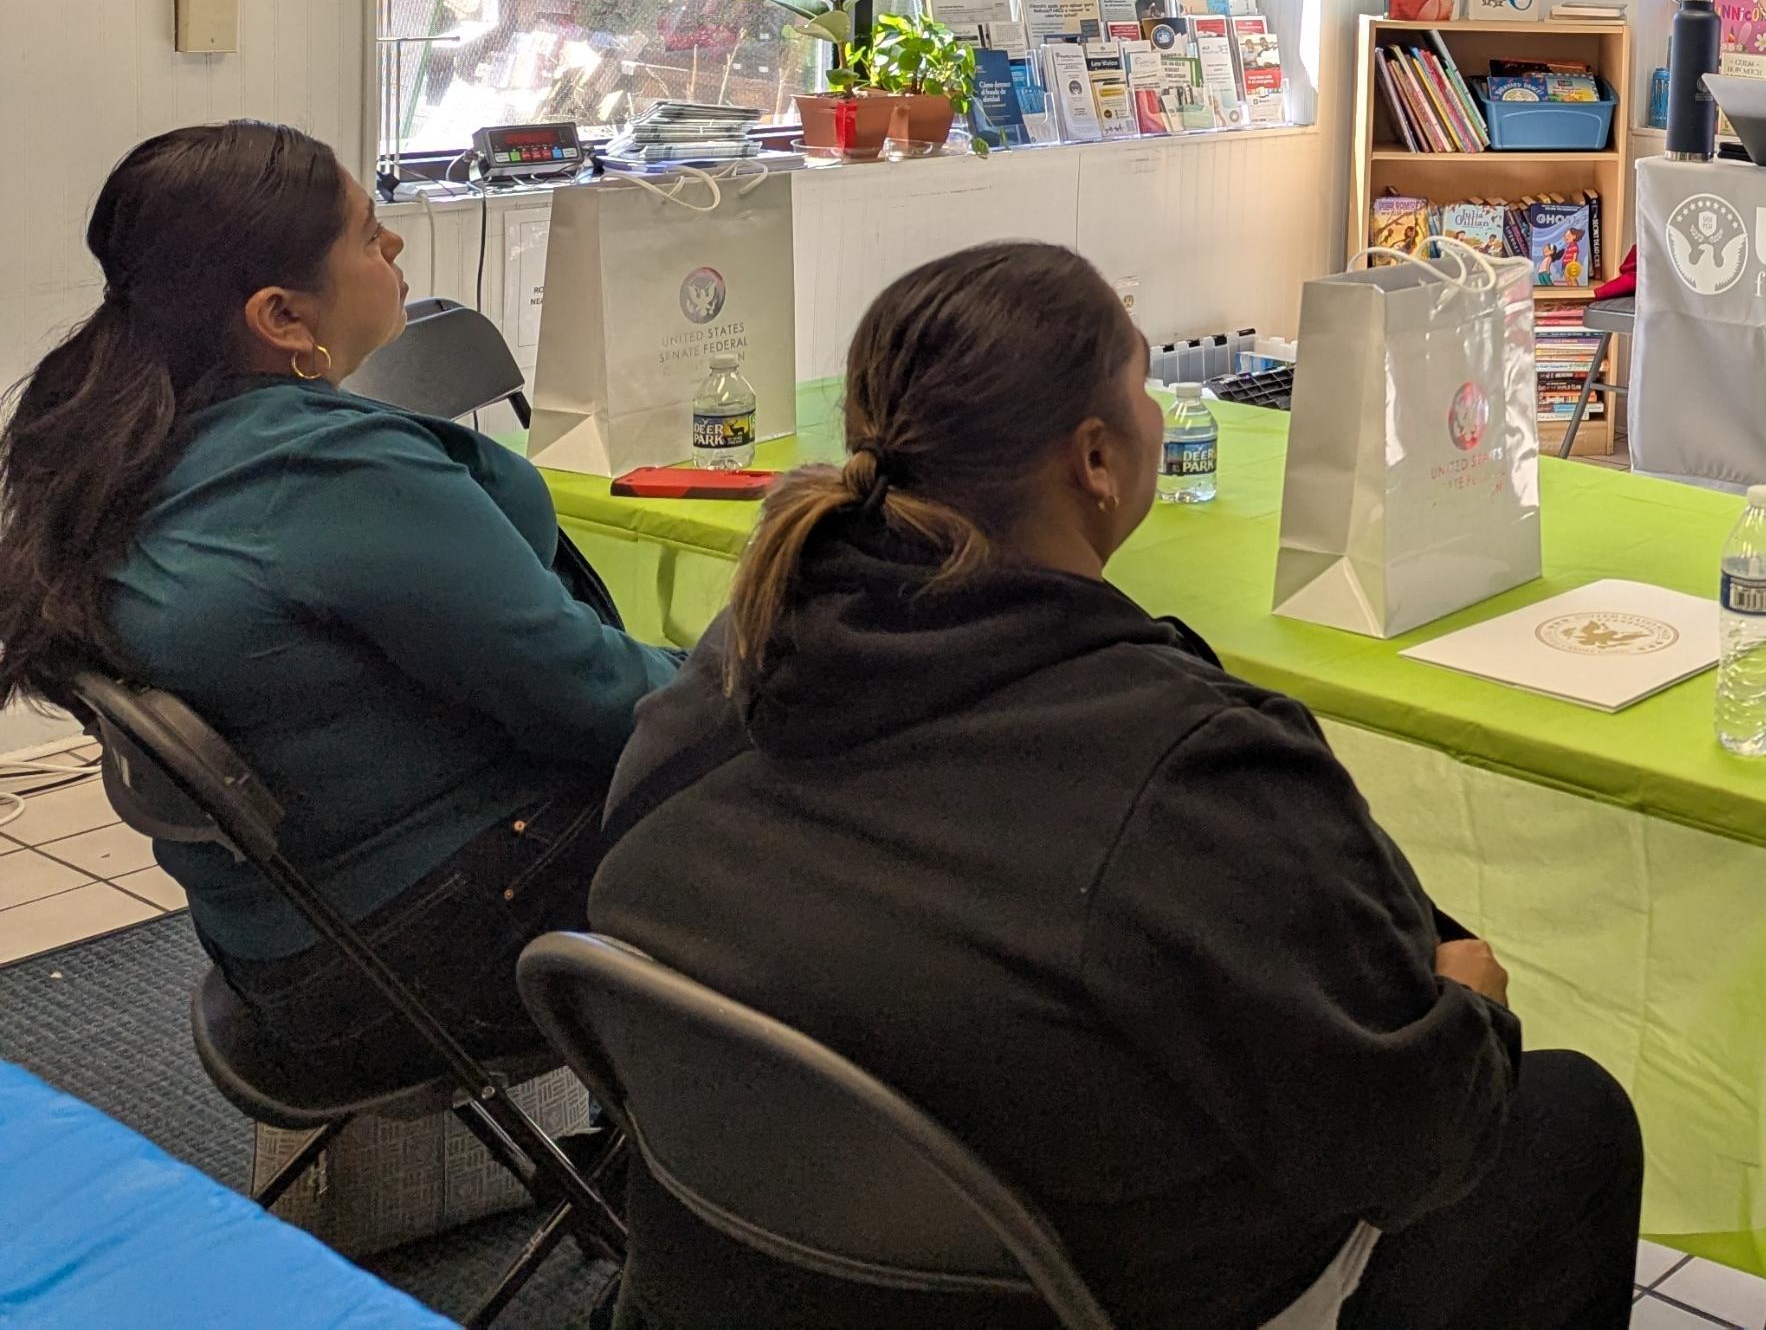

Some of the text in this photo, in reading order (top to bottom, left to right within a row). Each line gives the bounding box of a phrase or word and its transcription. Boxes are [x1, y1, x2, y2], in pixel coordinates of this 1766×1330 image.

[662, 322, 744, 347] UNITED STATES
[703, 336, 748, 355] FEDERAL
[694, 423, 724, 436] DEER
[694, 434, 726, 447] PARK
[1183, 449, 1214, 462] DEER
[1183, 460, 1214, 473] PARK
